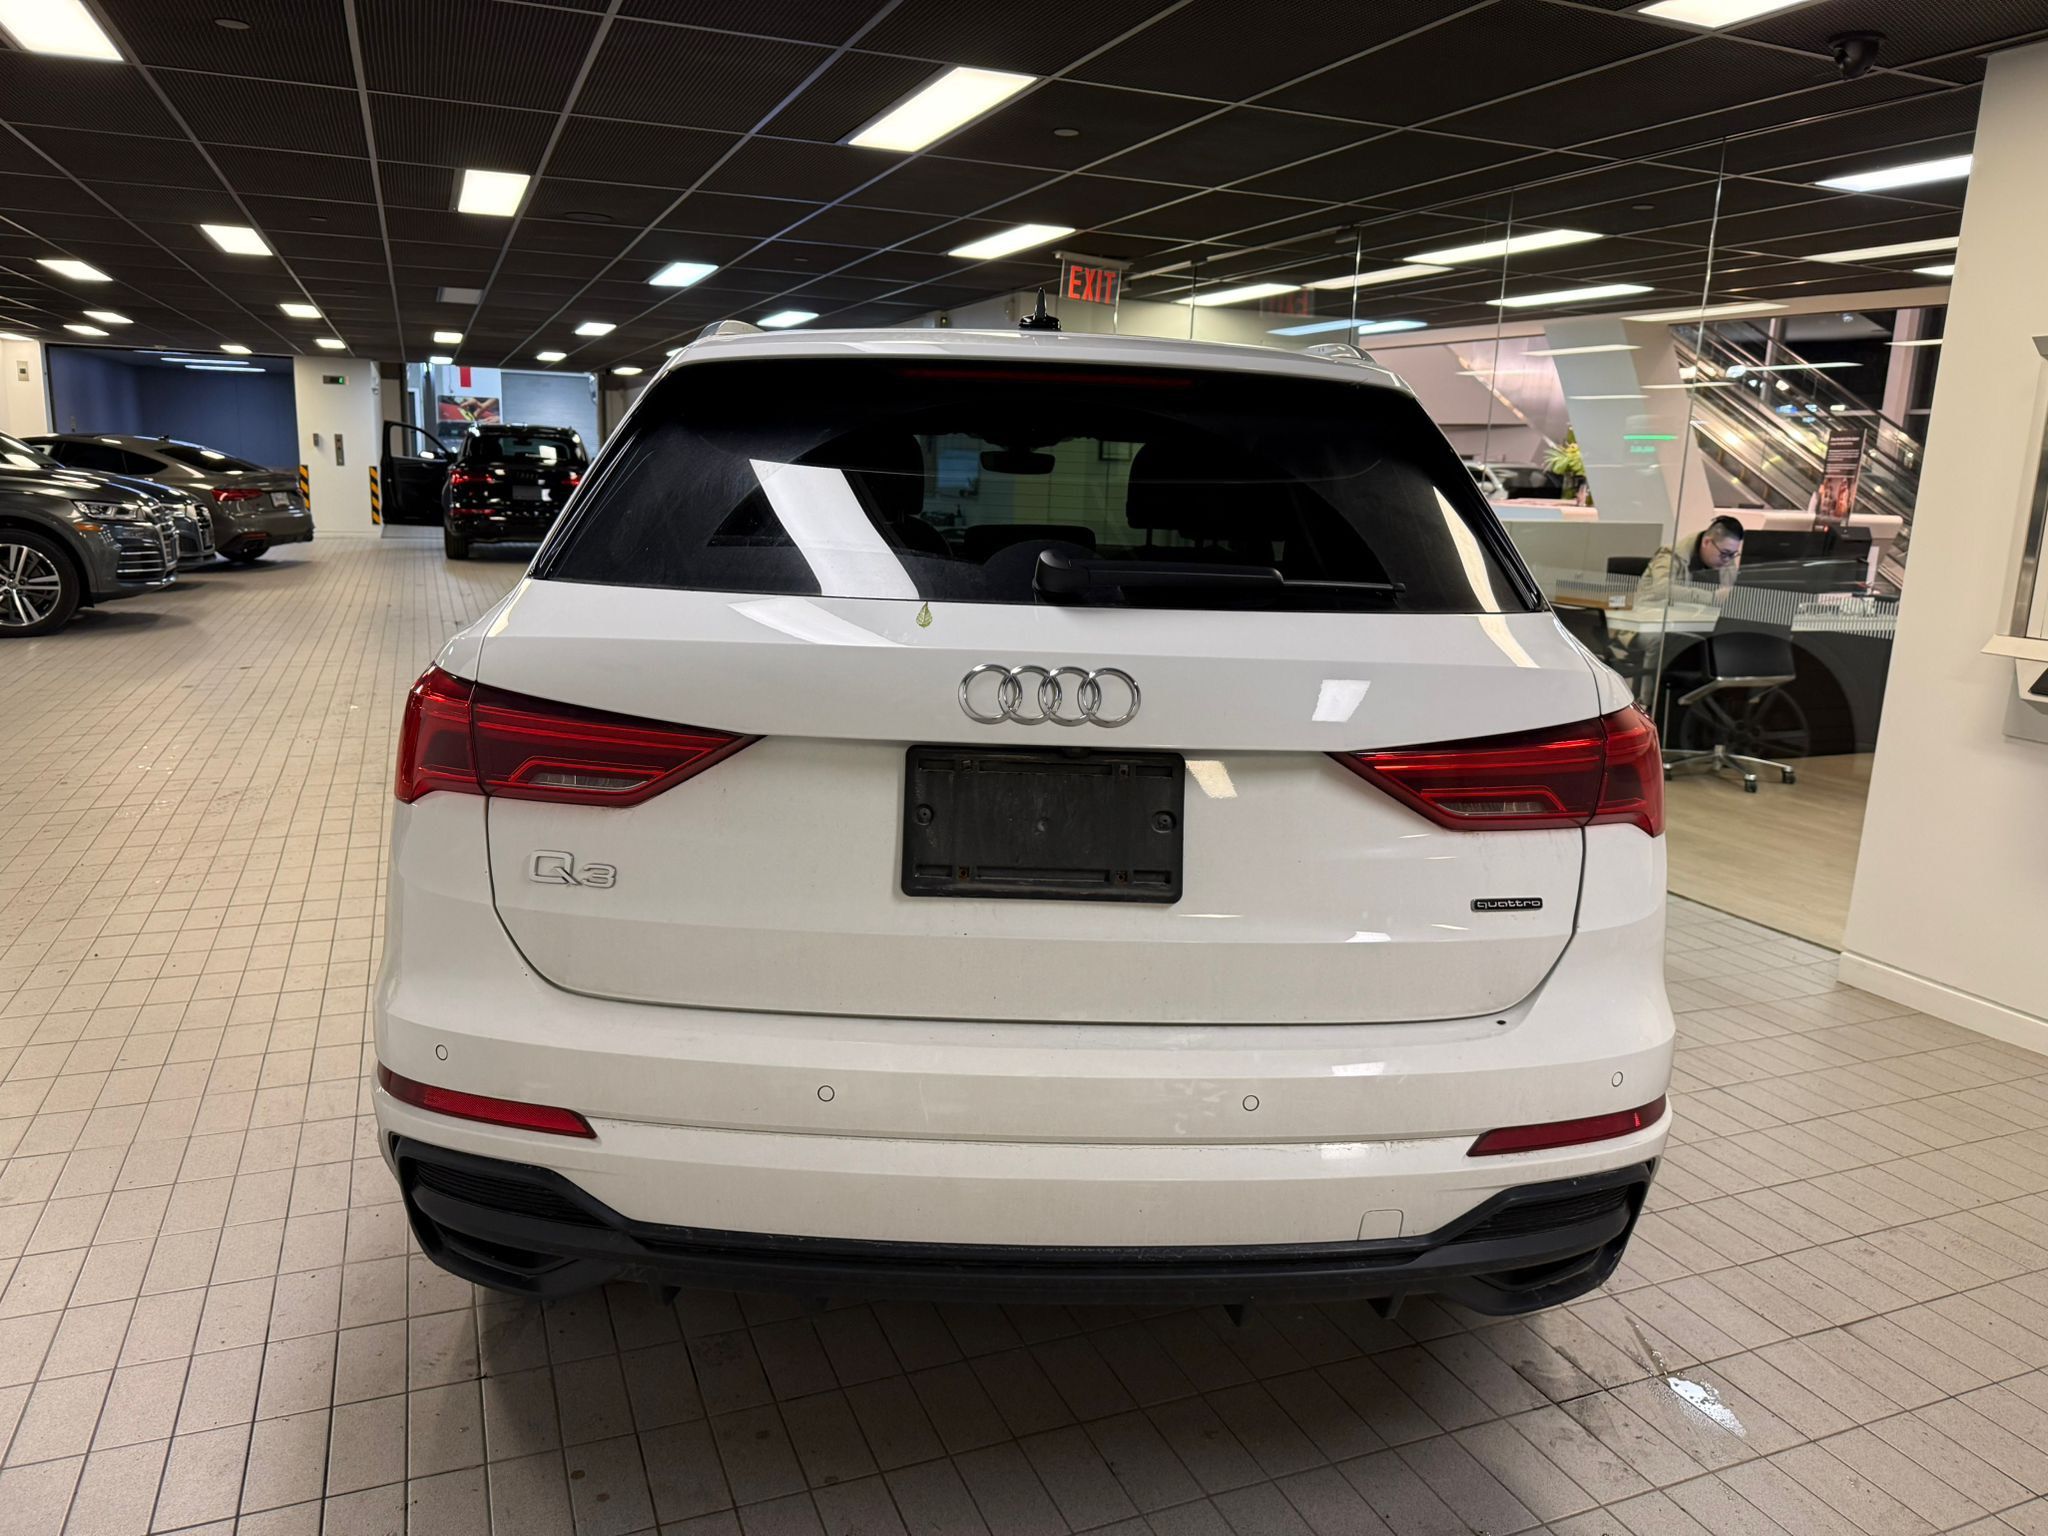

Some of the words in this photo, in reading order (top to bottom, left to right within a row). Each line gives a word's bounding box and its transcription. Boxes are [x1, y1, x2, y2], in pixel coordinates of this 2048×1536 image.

[1068, 265, 1116, 304] EXIT
[529, 849, 616, 888] Q3
[1476, 900, 1541, 909] quattro
